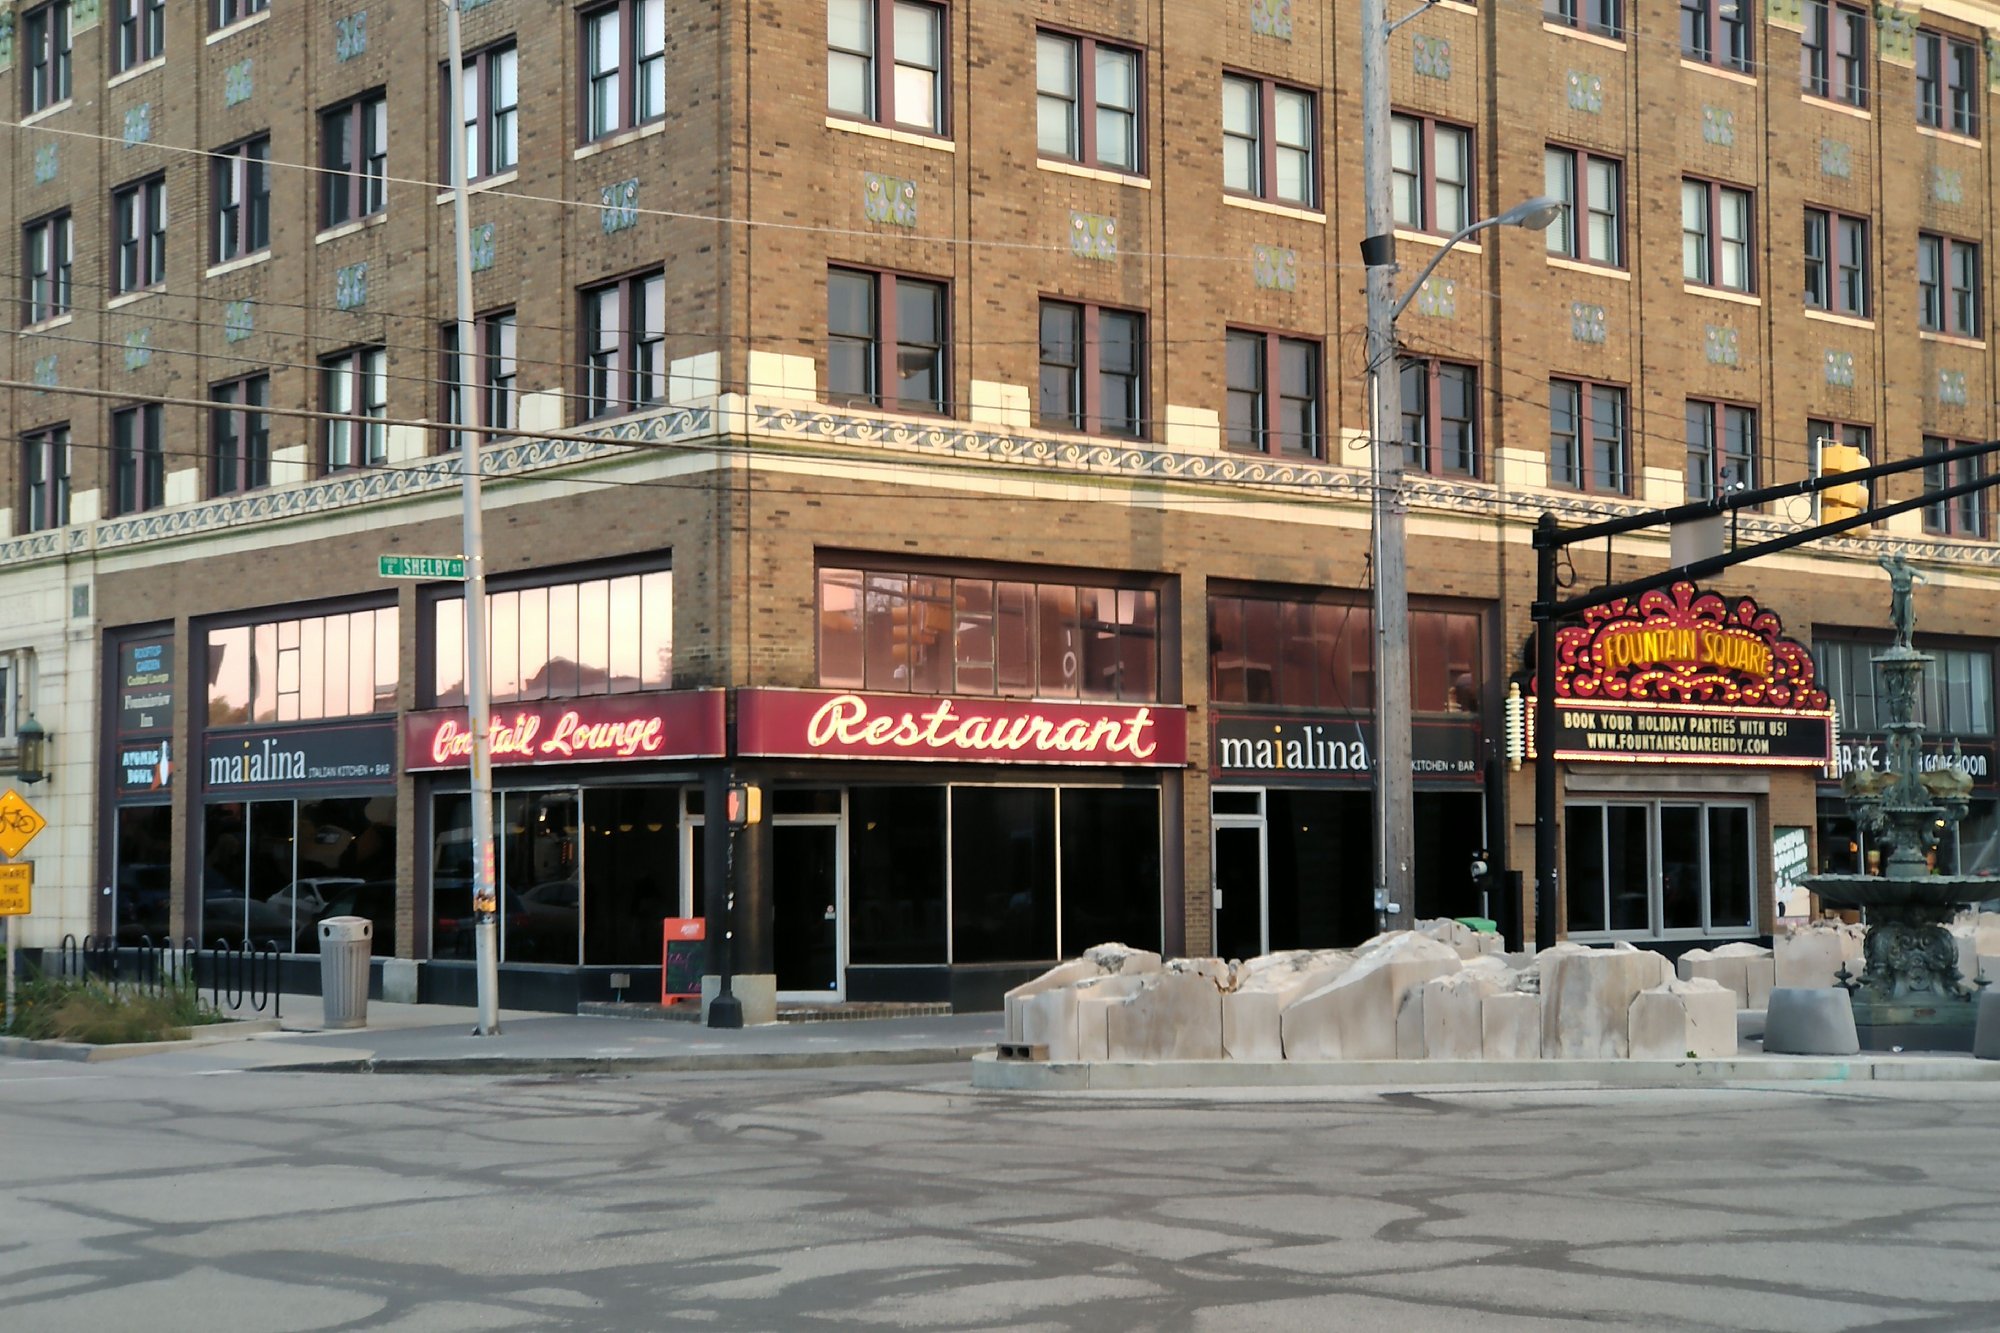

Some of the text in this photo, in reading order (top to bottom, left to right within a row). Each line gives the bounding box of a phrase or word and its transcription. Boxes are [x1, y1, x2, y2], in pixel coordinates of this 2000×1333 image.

[404, 558, 451, 576] SHELBY
[452, 563, 462, 573] ST
[1603, 628, 1771, 677] FOUNTAIN SQUARE
[136, 659, 160, 673] GARDEN
[807, 695, 1157, 758] Restaurant
[1563, 711, 1788, 737] BOOK YOUR HOLIDAY PARTIES WITH US!
[432, 711, 664, 763] Coctail Lounge
[1586, 733, 1769, 754] WWW.FOUNTAINSQUAREINDY.COM
[1220, 725, 1368, 770] maialina
[122, 750, 158, 766] ATOMIC
[209, 739, 306, 785] maialina
[1411, 760, 1449, 772] KITCHEN
[1458, 760, 1475, 772] BAR
[127, 769, 153, 784] BOWL
[308, 766, 336, 778] ITALIAN
[337, 764, 368, 777] KITCHEN
[375, 764, 390, 776] BAR
[0, 870, 27, 880] HARE
[4, 884, 19, 894] THE
